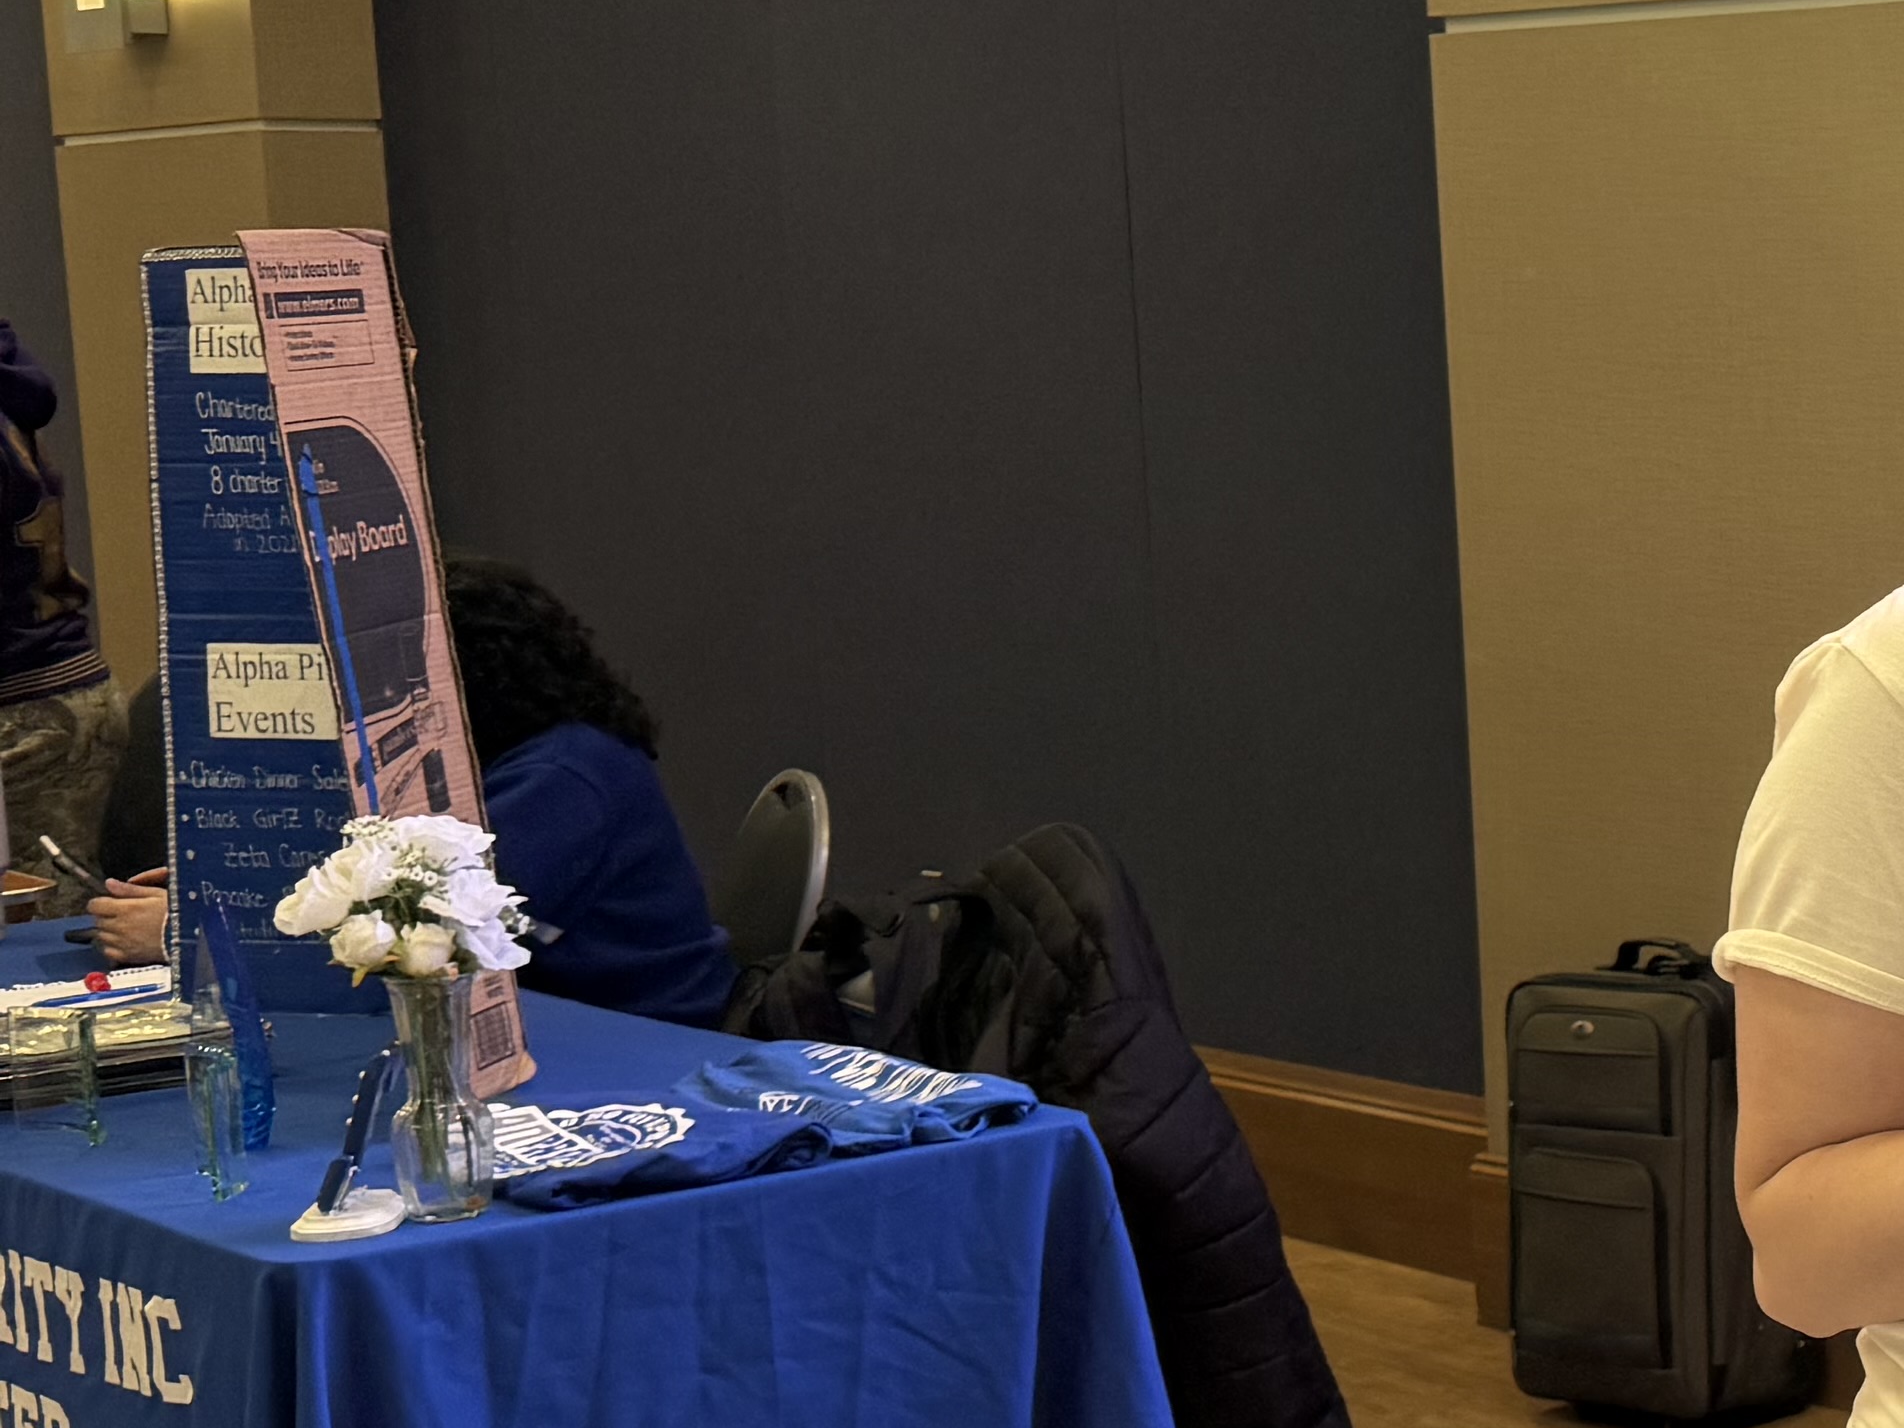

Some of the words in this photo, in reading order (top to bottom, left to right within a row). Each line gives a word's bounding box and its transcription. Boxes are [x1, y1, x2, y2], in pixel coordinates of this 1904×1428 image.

[201, 428, 267, 465] January
[211, 465, 224, 494] 8
[356, 514, 409, 552] Board
[211, 651, 289, 687] Alpha
[215, 701, 316, 734] Events
[98, 1276, 195, 1405] INC
